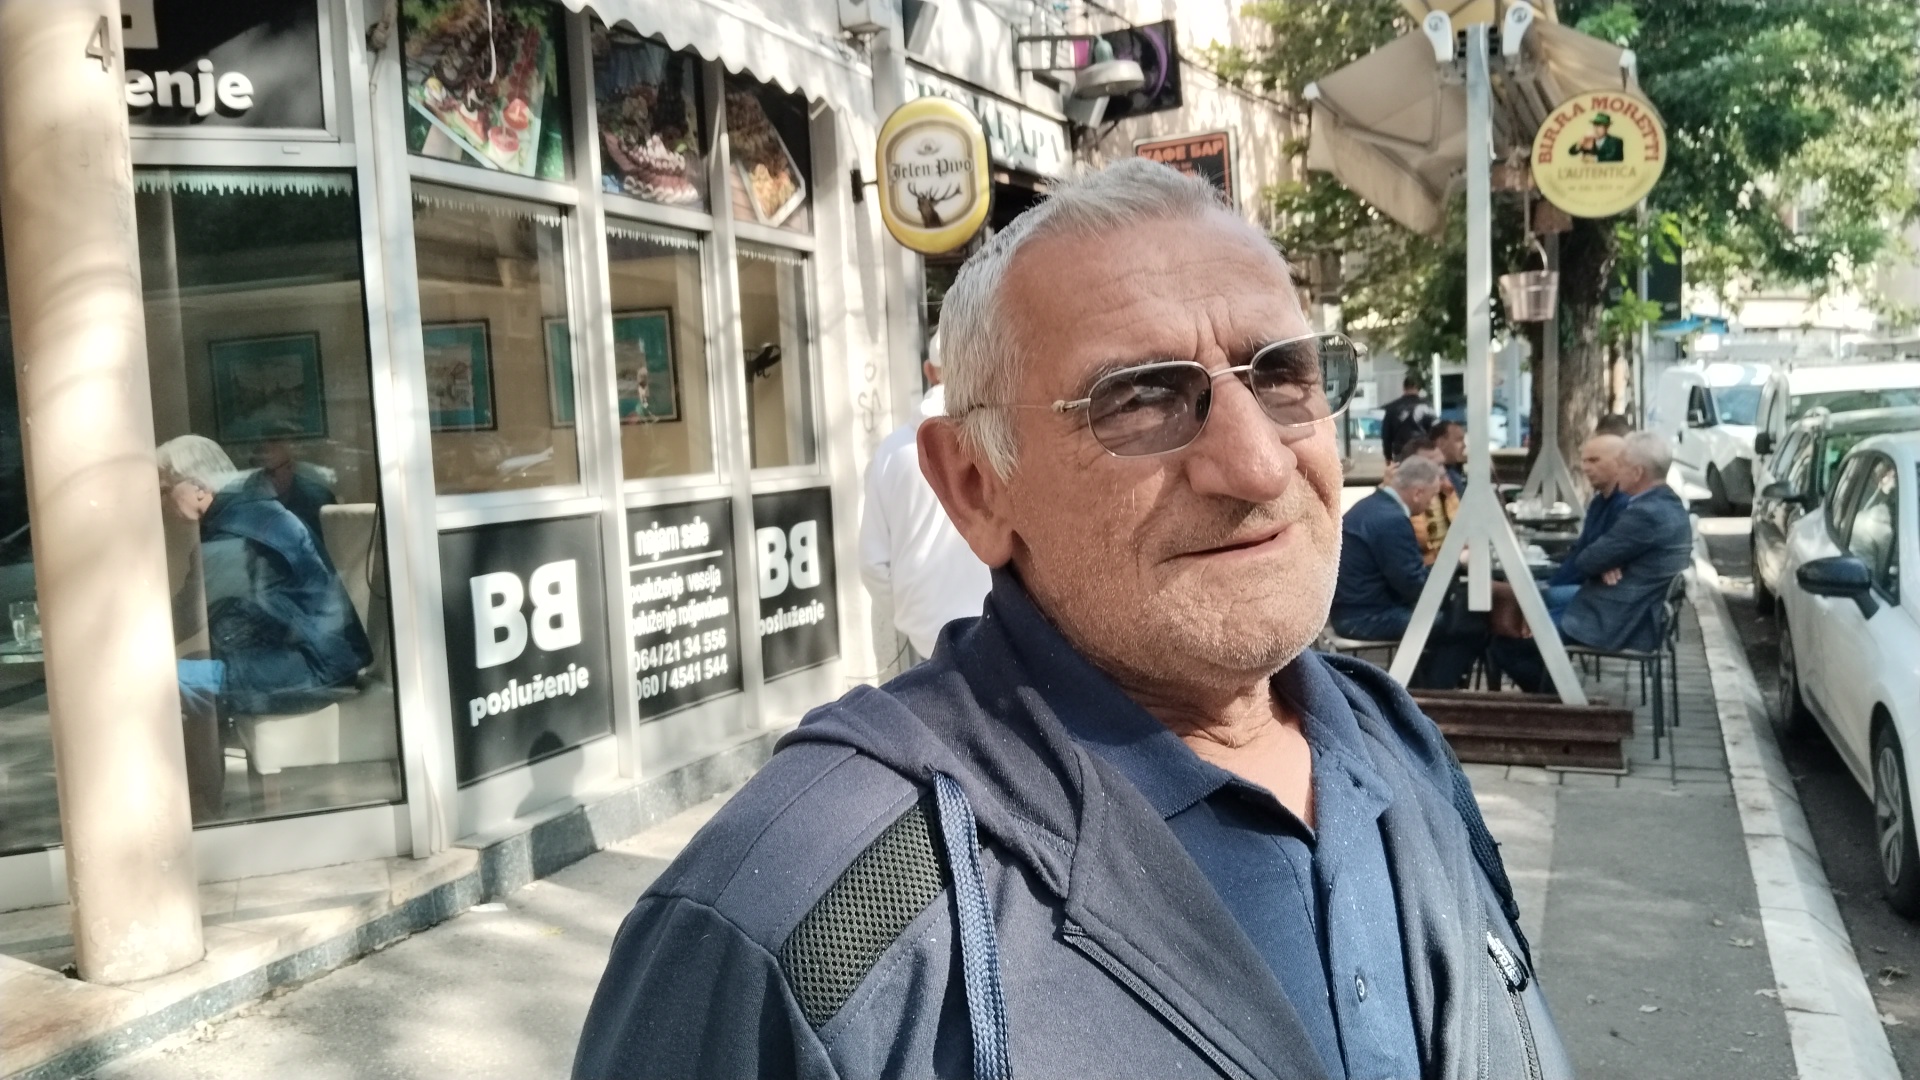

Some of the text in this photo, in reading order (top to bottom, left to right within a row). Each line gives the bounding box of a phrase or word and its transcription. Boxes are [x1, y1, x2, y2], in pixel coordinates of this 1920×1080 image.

[85, 15, 116, 73] 4
[1538, 96, 1660, 165] BIRRA MORETTI
[891, 158, 972, 182] Jelen Pivo
[1557, 166, 1637, 180] L'AUTENTICA
[634, 515, 709, 561] najam sale
[686, 564, 722, 593] veselja
[632, 604, 677, 635] osluženje
[682, 634, 701, 659] 34
[702, 627, 727, 653] 556
[668, 661, 702, 690] 4541
[703, 653, 729, 680] 544
[469, 662, 590, 727] posluženje
